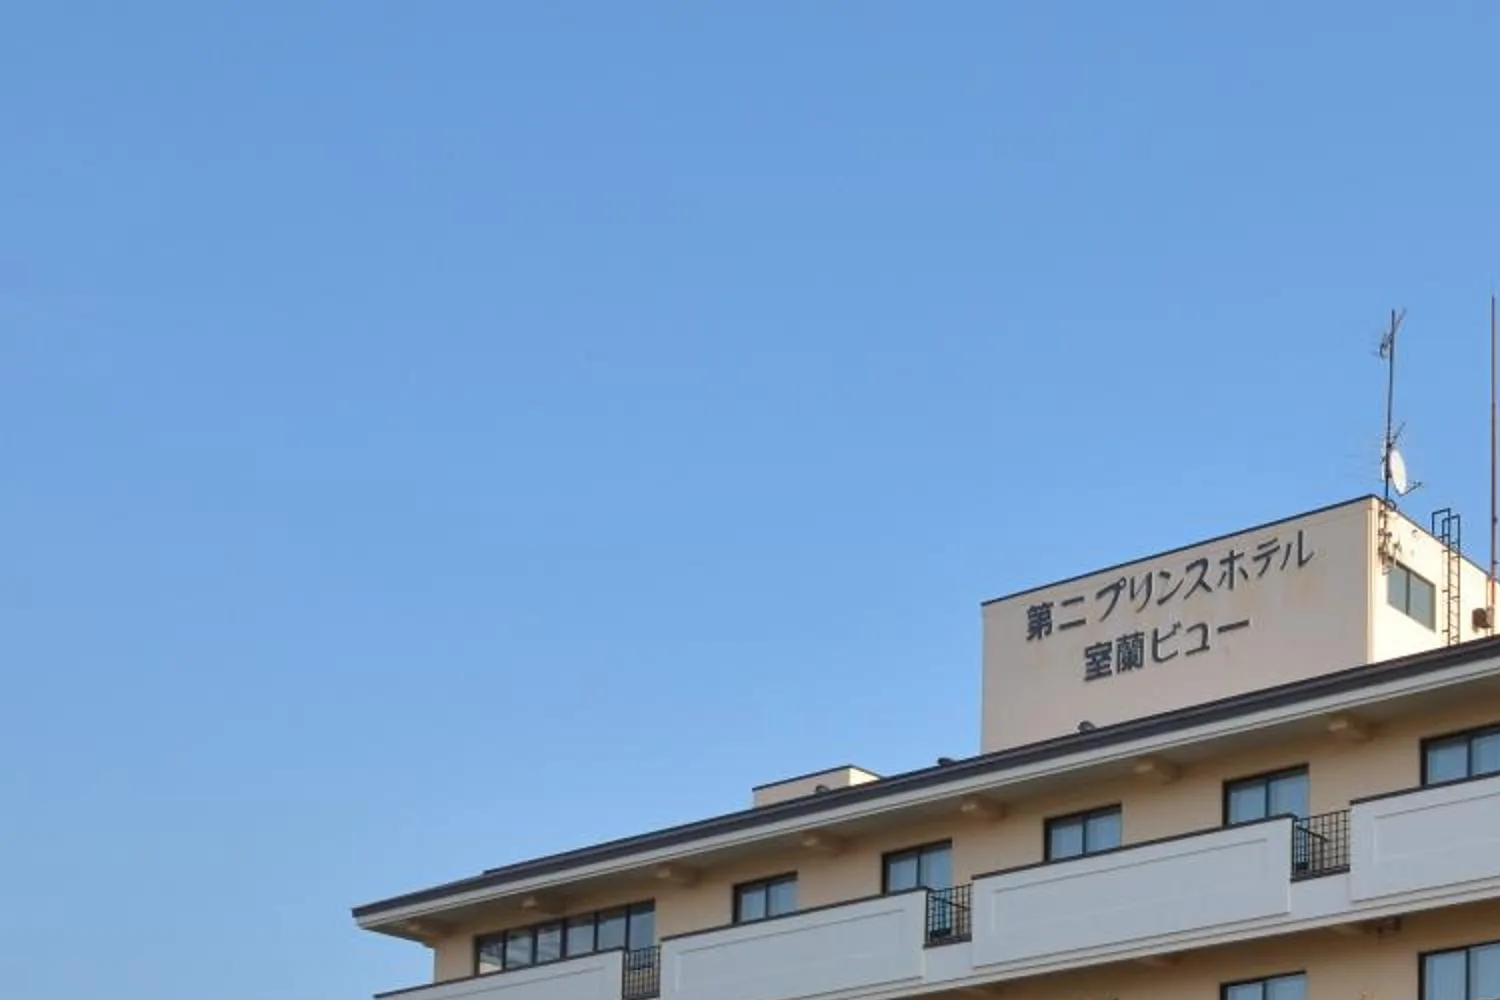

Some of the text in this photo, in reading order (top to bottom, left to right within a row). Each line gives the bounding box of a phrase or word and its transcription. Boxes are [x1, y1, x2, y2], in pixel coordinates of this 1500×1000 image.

[1026, 530, 1315, 641] 第二プリンスホテル
[1084, 619, 1250, 682] 室蘭ビュー
